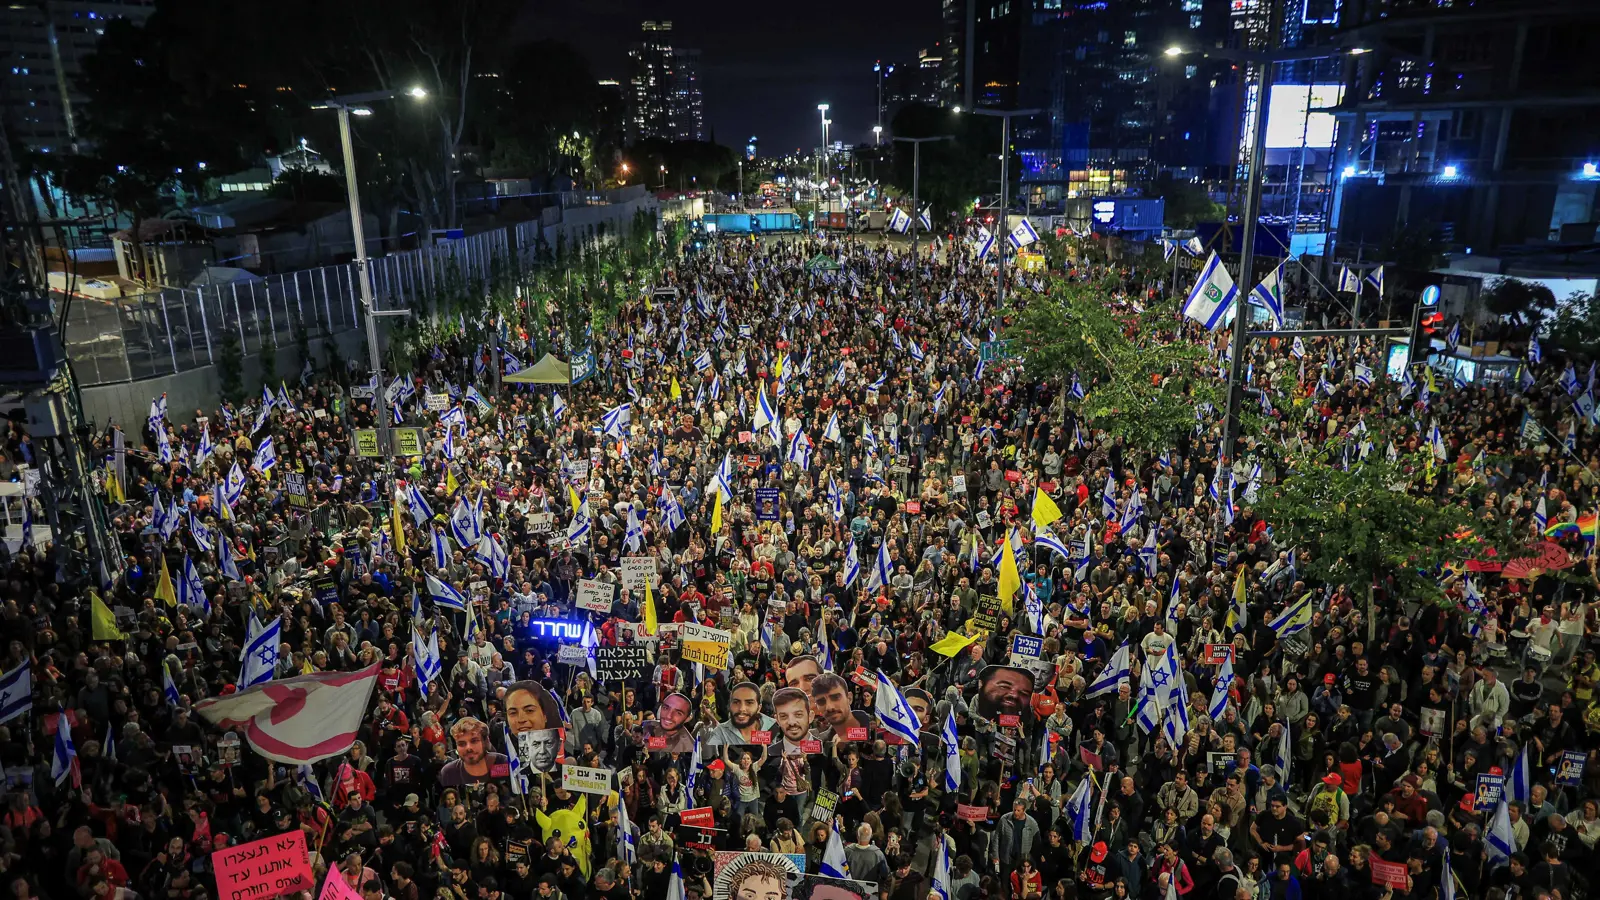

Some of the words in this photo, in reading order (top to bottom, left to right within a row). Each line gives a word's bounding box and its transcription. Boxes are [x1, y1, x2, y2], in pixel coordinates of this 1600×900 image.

[286, 482, 305, 496] THEM
[533, 621, 580, 638] שחרר
[685, 625, 700, 636] עבר
[702, 630, 729, 643] התקציב
[1018, 637, 1038, 648] הגליל
[718, 645, 728, 654] על
[1018, 646, 1036, 655] נלחם
[600, 659, 645, 668] המדינה
[577, 769, 589, 778] עם
[815, 795, 836, 810] HOME
[276, 838, 296, 850] לא
[698, 832, 712, 844] כל
[224, 845, 269, 867] תעצרו
[258, 858, 293, 875] אותנו
[229, 868, 250, 883] עד
[276, 875, 302, 888] שהם
[232, 882, 270, 900] חוזרים
